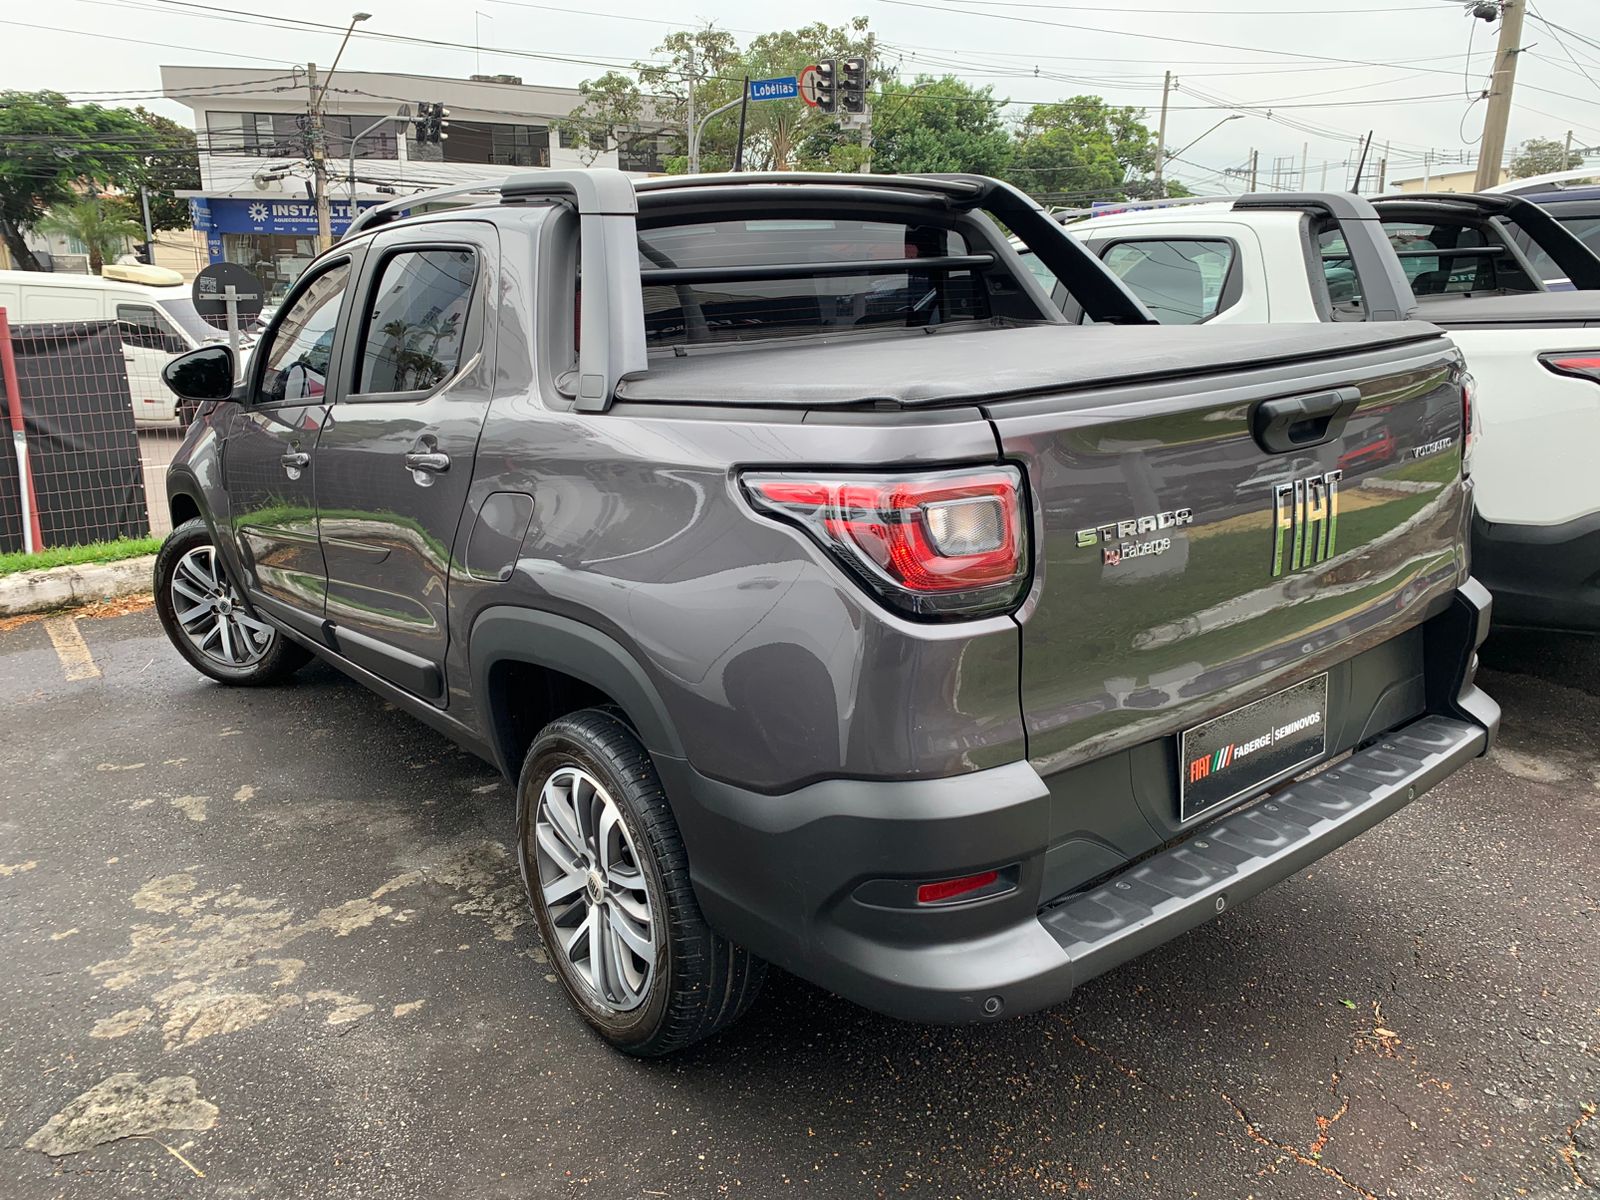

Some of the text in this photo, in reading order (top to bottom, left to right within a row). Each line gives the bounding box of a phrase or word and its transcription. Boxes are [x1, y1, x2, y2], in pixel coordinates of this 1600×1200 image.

[272, 204, 367, 217] INSTALTEC
[1076, 507, 1194, 548] STRADA
[1272, 469, 1343, 577] FIAT
[1103, 537, 1171, 566] by Faberge
[1190, 711, 1321, 783] FIAT FABERGE SEMINOVOS
